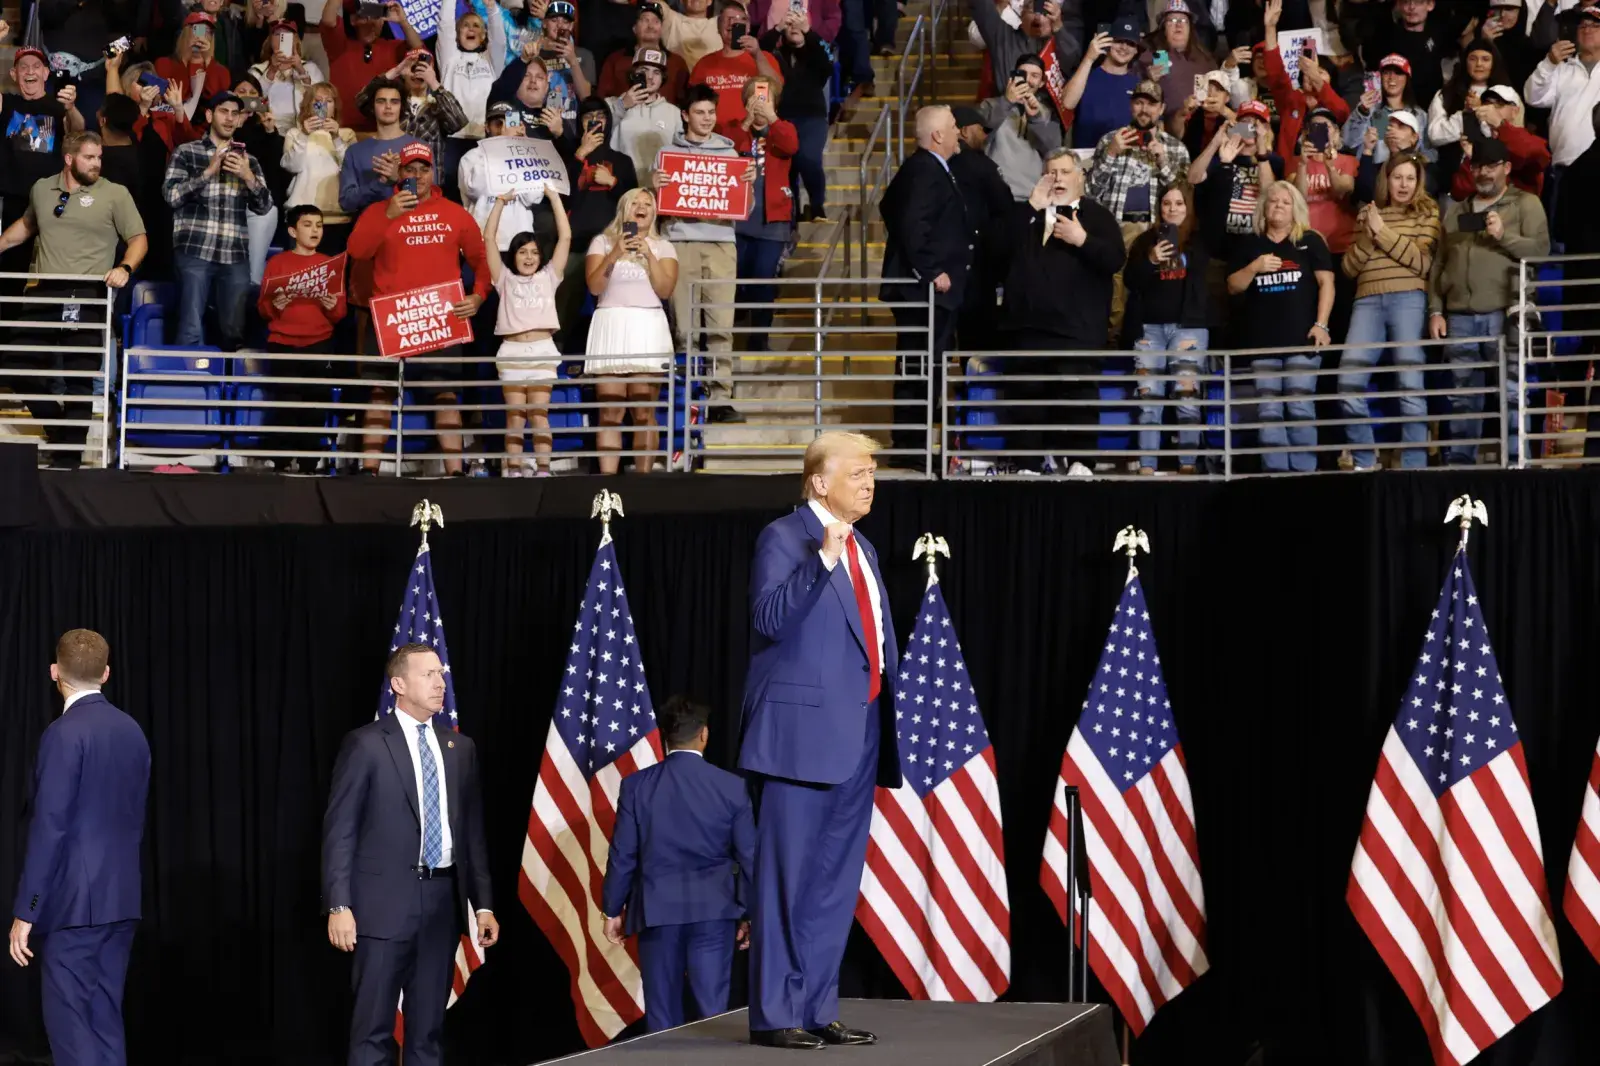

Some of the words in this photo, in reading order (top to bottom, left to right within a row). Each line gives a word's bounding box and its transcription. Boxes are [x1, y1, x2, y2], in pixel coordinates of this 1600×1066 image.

[507, 145, 539, 156] TEXT
[505, 158, 550, 170] TRUMP
[684, 160, 727, 174] MAKE
[498, 173, 518, 184] TO
[523, 170, 563, 182] 88022
[670, 171, 738, 187] AMERICA
[678, 184, 729, 198] GREAT
[676, 197, 729, 211] AGAIN!
[409, 213, 438, 223] KEEP
[398, 223, 452, 234] AMERICA
[405, 234, 445, 246] GREAT
[273, 270, 337, 293] AMERICA
[288, 265, 328, 285] MAKE
[1255, 271, 1303, 287] TRUMP
[395, 291, 440, 311] MAKE
[386, 301, 454, 326] AMERICA
[397, 315, 447, 336] GREAT
[399, 326, 452, 349] AGAIN!
